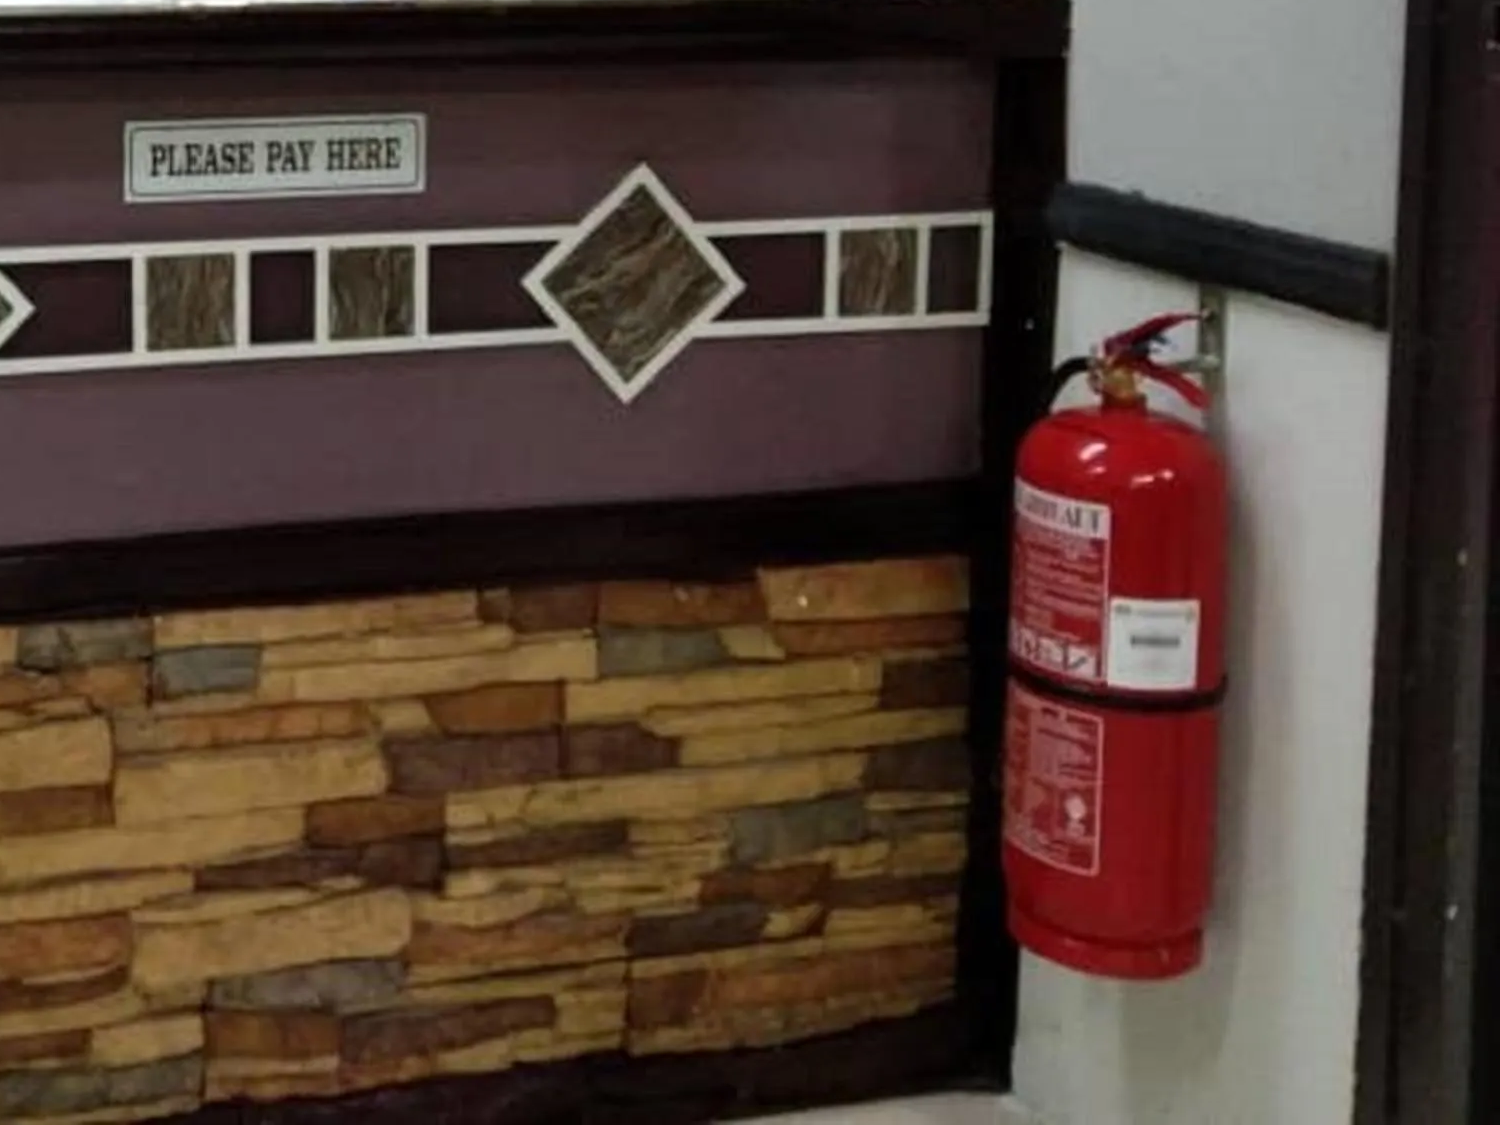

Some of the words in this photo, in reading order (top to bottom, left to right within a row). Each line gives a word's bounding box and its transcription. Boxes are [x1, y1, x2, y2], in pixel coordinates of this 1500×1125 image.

[150, 142, 255, 176] PLEASE
[266, 140, 315, 173] PAY
[326, 137, 401, 171] HERE
